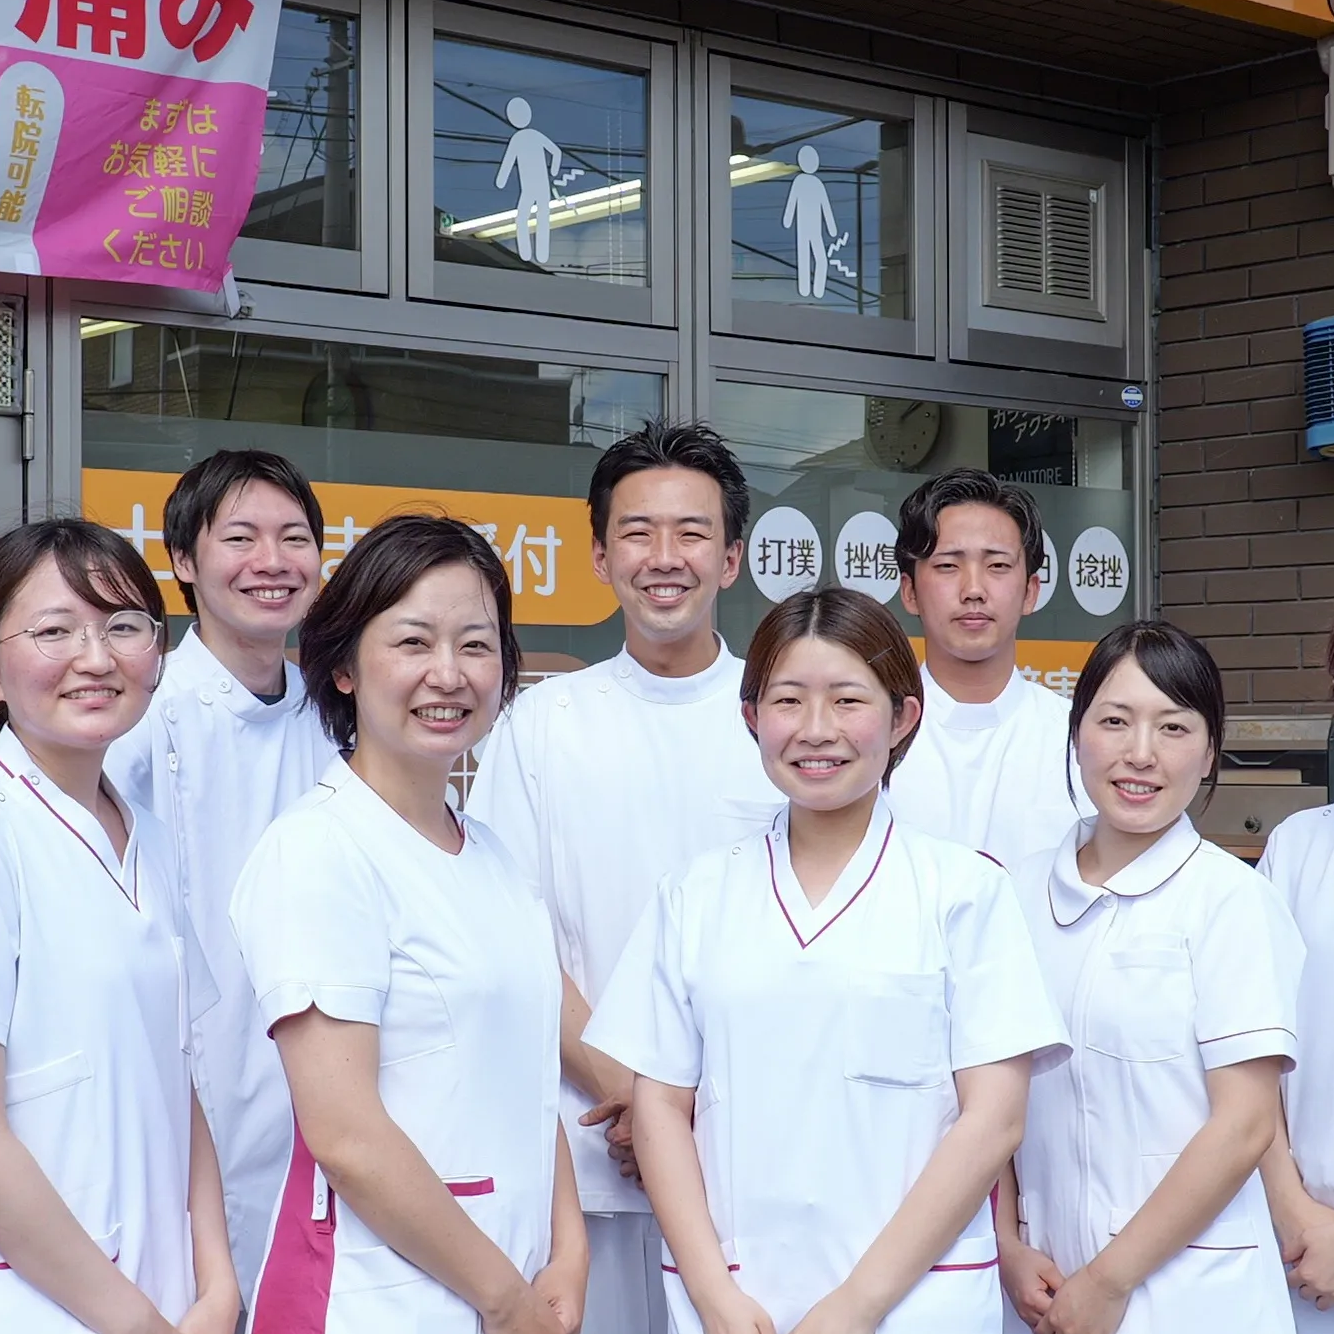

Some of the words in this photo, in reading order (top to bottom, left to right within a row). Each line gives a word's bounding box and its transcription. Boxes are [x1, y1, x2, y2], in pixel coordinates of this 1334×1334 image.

[138, 97, 219, 136] まずは
[103, 141, 219, 179] お気軽に
[123, 187, 214, 230] ご相談
[102, 229, 206, 271] ください
[757, 537, 816, 577] 打撲
[844, 542, 899, 580] 挫傷
[1075, 553, 1124, 589] 捻挫
